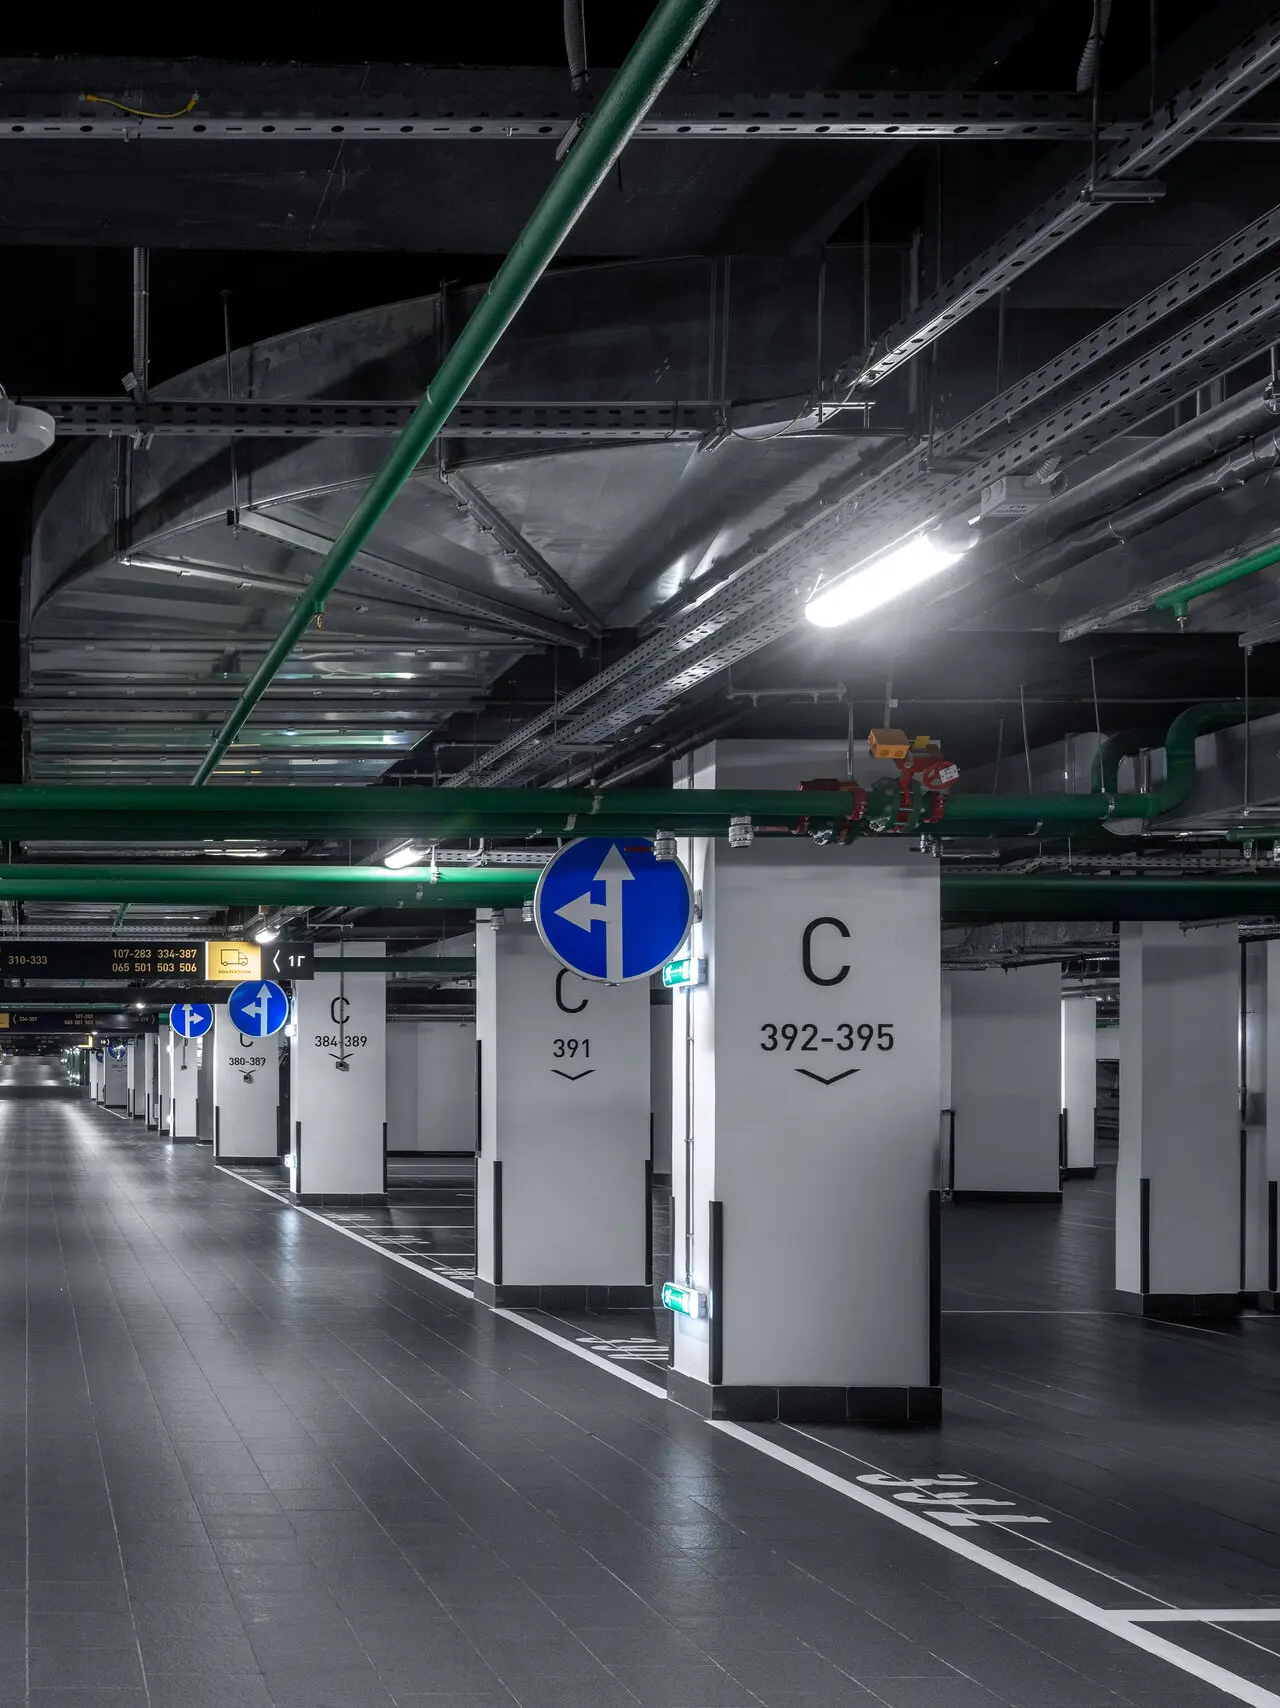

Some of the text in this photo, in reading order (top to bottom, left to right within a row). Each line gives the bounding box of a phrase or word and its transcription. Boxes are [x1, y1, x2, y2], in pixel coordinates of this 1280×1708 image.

[112, 949, 197, 959] 107-283 334-387
[802, 916, 851, 987] C
[8, 955, 48, 965] 310-333
[288, 955, 306, 967] 1Г
[112, 963, 197, 973] 065 501 503 506
[555, 967, 589, 1013] C
[330, 996, 350, 1024] C
[314, 1035, 368, 1047] 384-389
[760, 1023, 894, 1052] 392-395
[553, 1039, 590, 1058] 391
